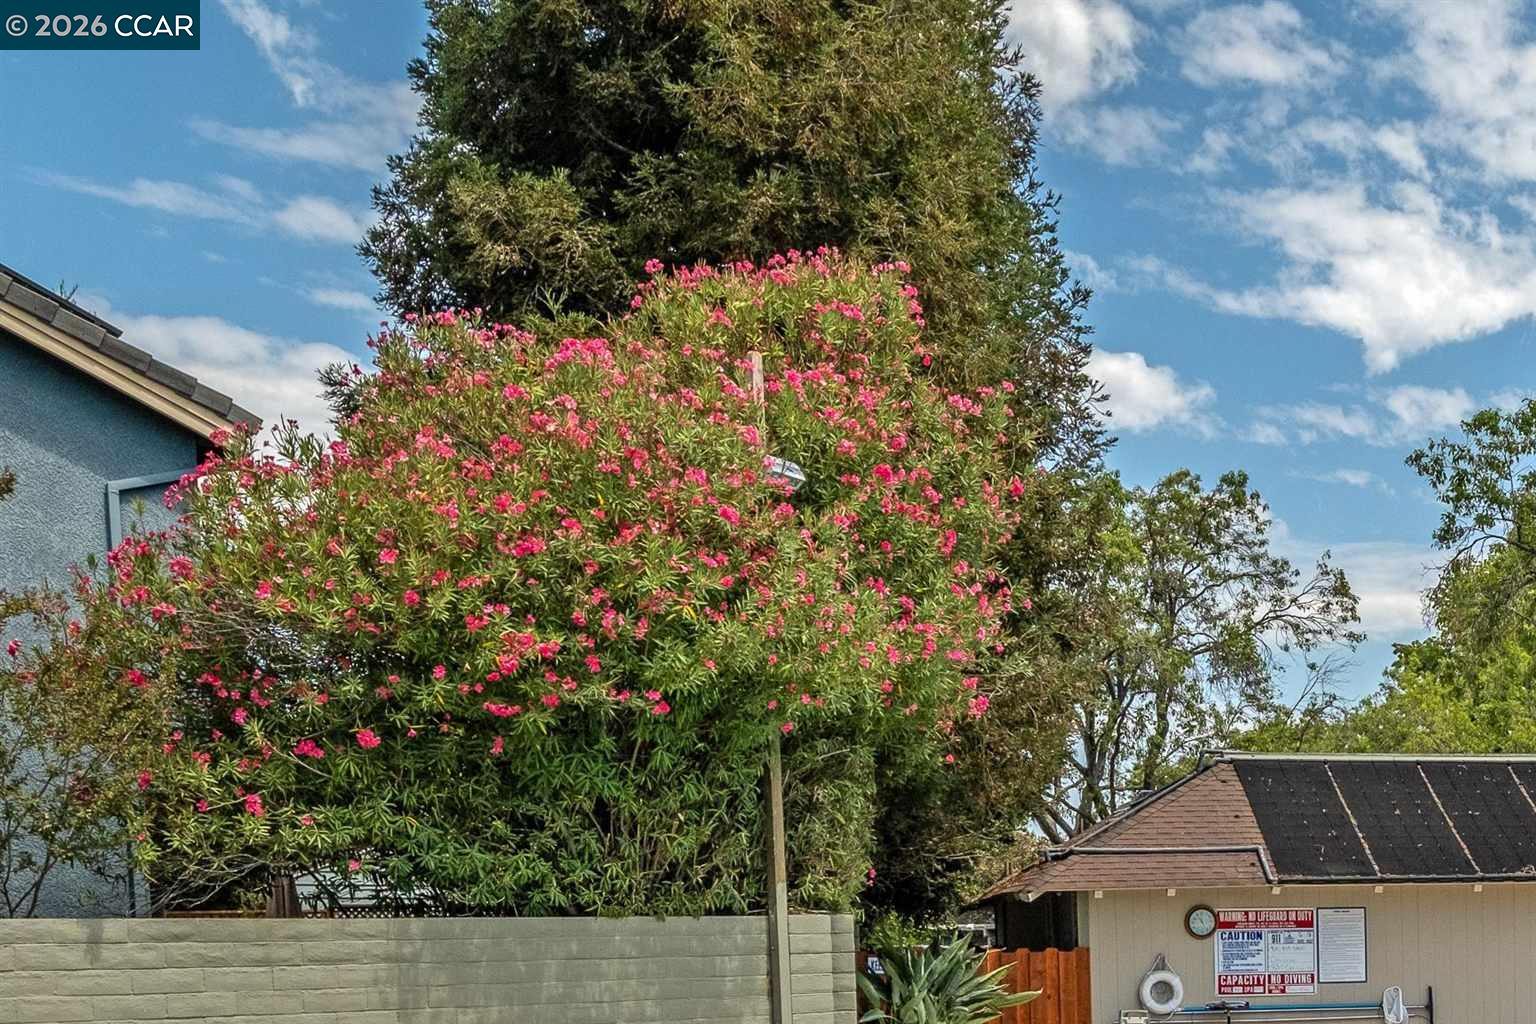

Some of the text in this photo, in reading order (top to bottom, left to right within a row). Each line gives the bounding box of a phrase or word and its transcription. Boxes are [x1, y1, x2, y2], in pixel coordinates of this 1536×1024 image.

[1248, 911, 1257, 921] NO
[1257, 911, 1288, 921] LIFEGUARD
[1288, 911, 1297, 921] ON
[1297, 911, 1312, 921] DUTY
[1220, 931, 1263, 941] CAUTION
[1271, 933, 1281, 944] 911
[1220, 975, 1265, 985] CAPACITY
[1271, 974, 1312, 984] NO DIVING
